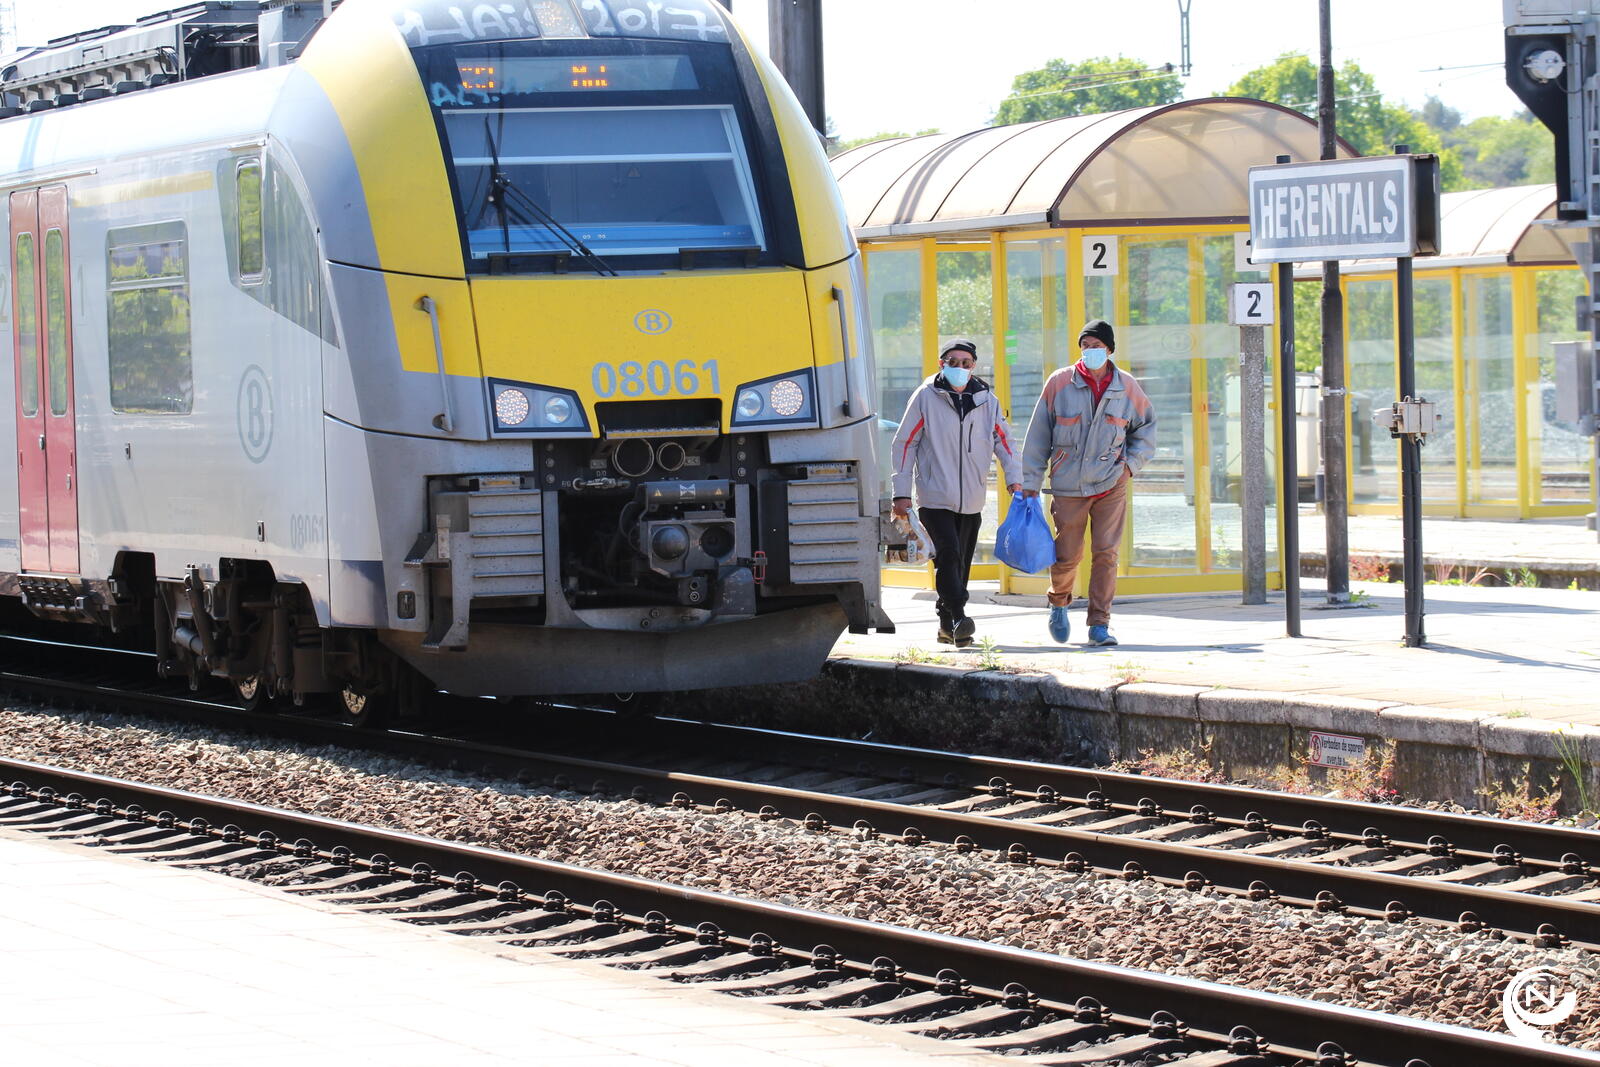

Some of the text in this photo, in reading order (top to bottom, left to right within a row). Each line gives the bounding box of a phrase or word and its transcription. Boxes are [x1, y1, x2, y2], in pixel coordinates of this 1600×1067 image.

[1259, 179, 1399, 240] HERENTALS
[1092, 242, 1107, 269] 2
[1247, 290, 1262, 317] 2
[590, 359, 721, 399] 08061
[289, 513, 325, 548] 08061
